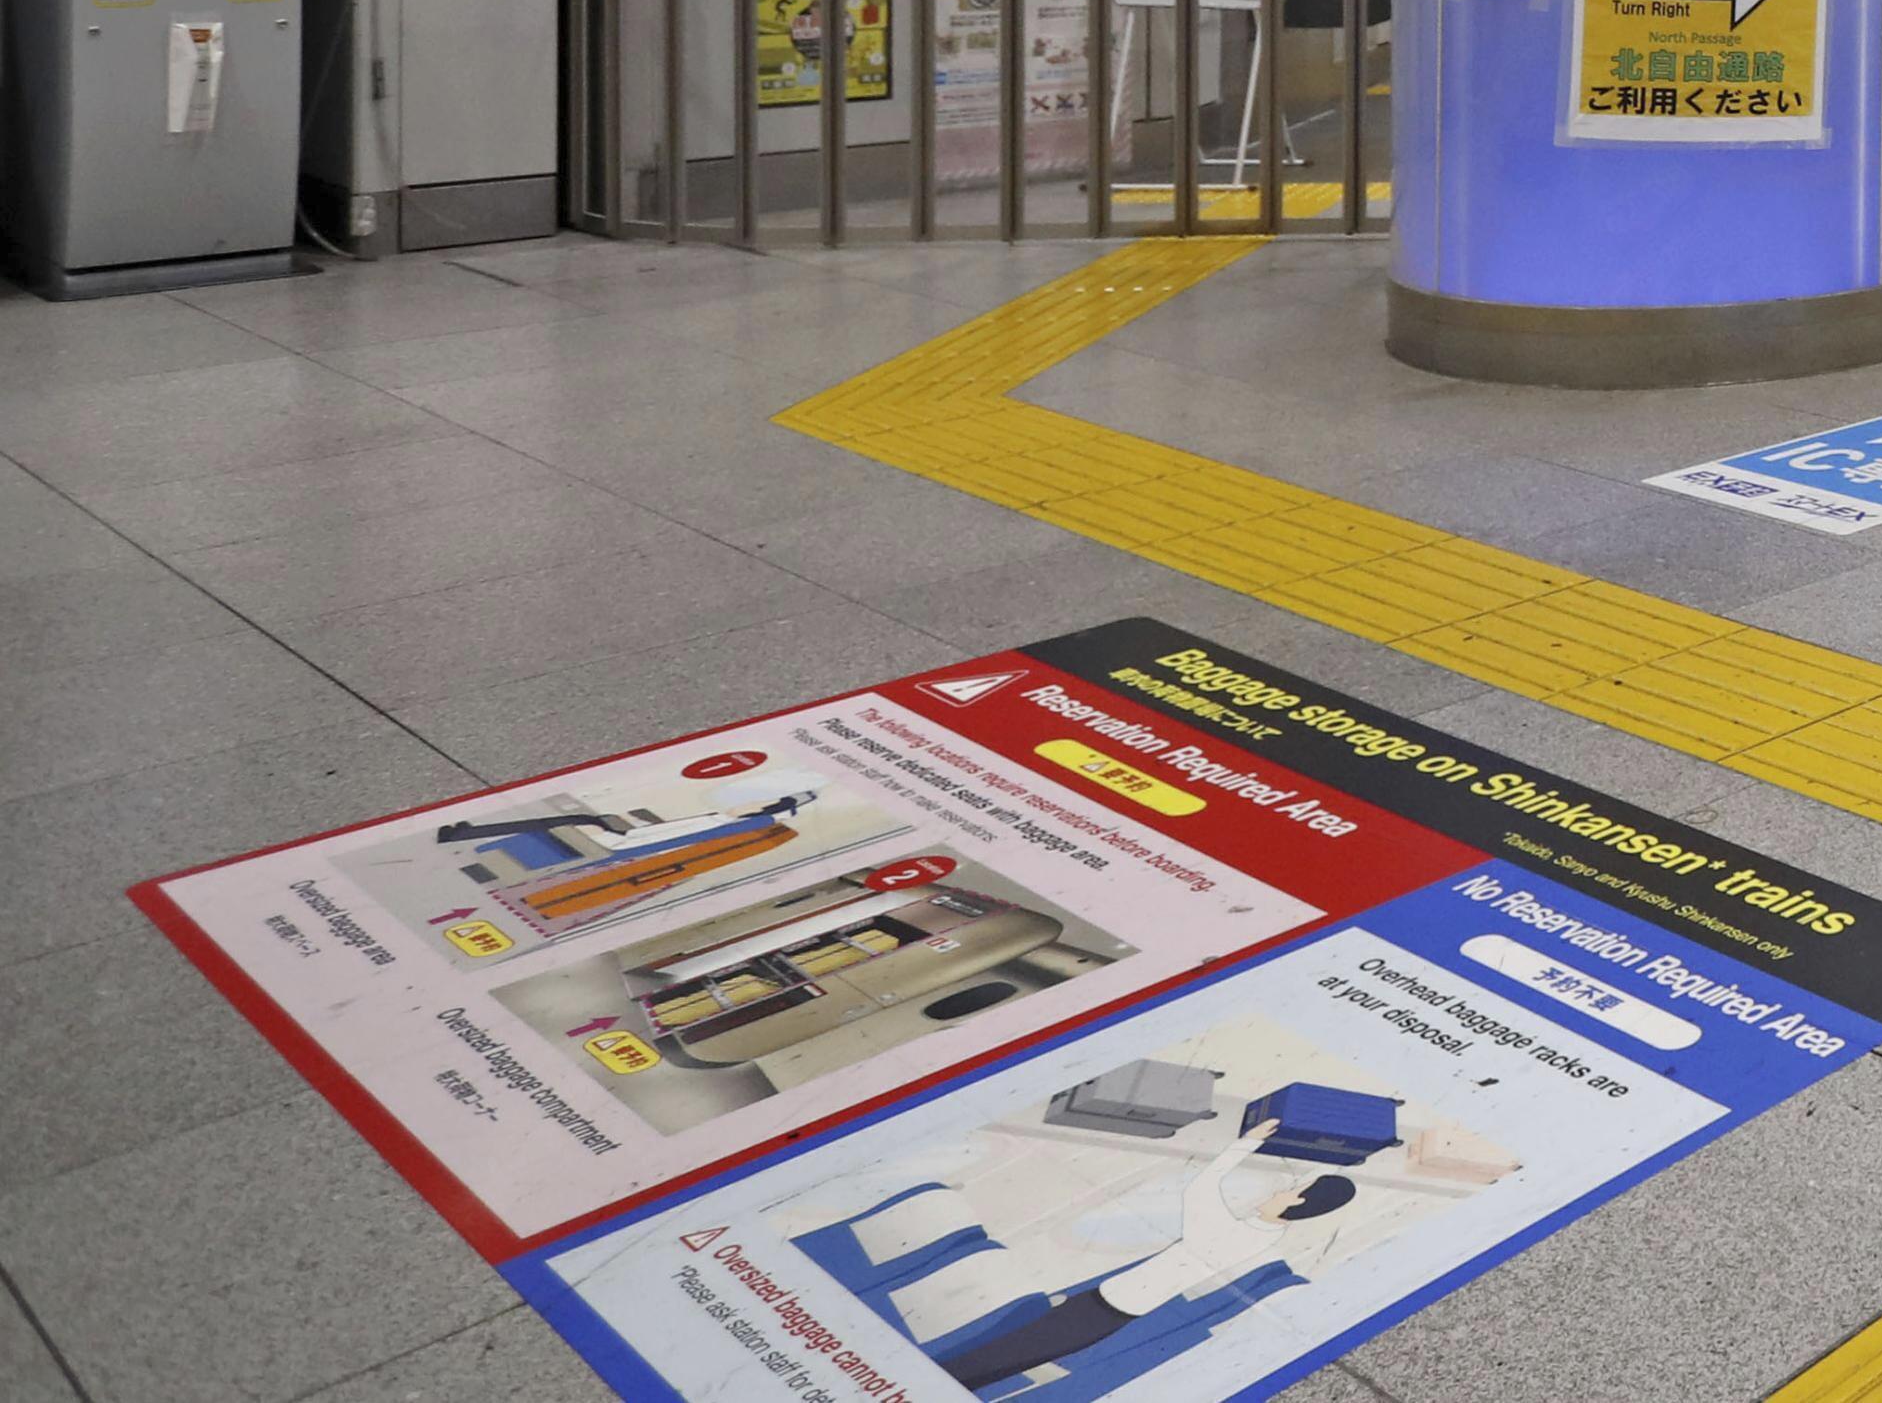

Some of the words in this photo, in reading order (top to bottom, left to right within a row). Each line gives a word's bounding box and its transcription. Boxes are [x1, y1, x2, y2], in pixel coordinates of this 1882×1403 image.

[1612, 0, 1646, 17] Turn
[1651, 0, 1691, 21] Right
[1648, 30, 1686, 45] North
[1691, 31, 1742, 48] Passage
[1587, 85, 1803, 116] ご利用ください
[1610, 48, 1785, 84] 北自由通路
[817, 716, 863, 740] Please
[852, 736, 904, 763] reserve
[895, 756, 965, 793] dedicated
[951, 784, 993, 810] seats
[987, 804, 1023, 826] with
[1013, 817, 1076, 853] baggage
[1070, 846, 1111, 872] area.
[855, 707, 884, 724] The
[876, 718, 931, 749] following
[924, 744, 985, 775] locations
[978, 770, 1028, 803] require
[1023, 794, 1105, 837] reservations
[1100, 827, 1150, 860] before
[1145, 853, 1219, 893] boarding.
[1020, 684, 1172, 755] Reservation
[1157, 745, 1298, 807] Required
[1274, 799, 1358, 838] Area
[1155, 648, 1301, 710] Baggage
[1288, 703, 1426, 758] storage
[1416, 754, 1479, 783] on
[1712, 868, 1855, 936] trains
[288, 878, 342, 918] Oversized
[327, 912, 378, 949] baggage
[362, 945, 397, 967] area
[882, 869, 920, 885] 2
[1553, 854, 1598, 879] Sanyo
[1593, 872, 1628, 889] and
[1622, 882, 1676, 912] Kyushu
[1673, 904, 1760, 947] Shinkansen
[1756, 938, 1795, 961] only
[1452, 873, 1495, 903] No
[1488, 890, 1647, 968] Reservation
[1634, 953, 1779, 1025] Required
[1759, 1010, 1848, 1059] Area
[1531, 966, 1626, 1013] 予約不要
[1317, 974, 1343, 990] at
[1338, 984, 1392, 1012] your
[1382, 1005, 1475, 1058] disposal.
[1358, 956, 1452, 1008] Overhead
[1444, 998, 1533, 1050] baggage
[1528, 1041, 1592, 1080] racks
[1586, 1073, 1630, 1099] are
[435, 1006, 502, 1055] Oversized
[483, 1042, 544, 1094] baggage
[528, 1085, 624, 1156] compartment
[705, 1301, 738, 1323] ask
[725, 1315, 771, 1356] station
[760, 1349, 803, 1378] staff
[784, 1370, 814, 1391] for
[713, 1243, 793, 1304] Oversized
[773, 1295, 843, 1355] baggage
[831, 1350, 897, 1397] cannot
